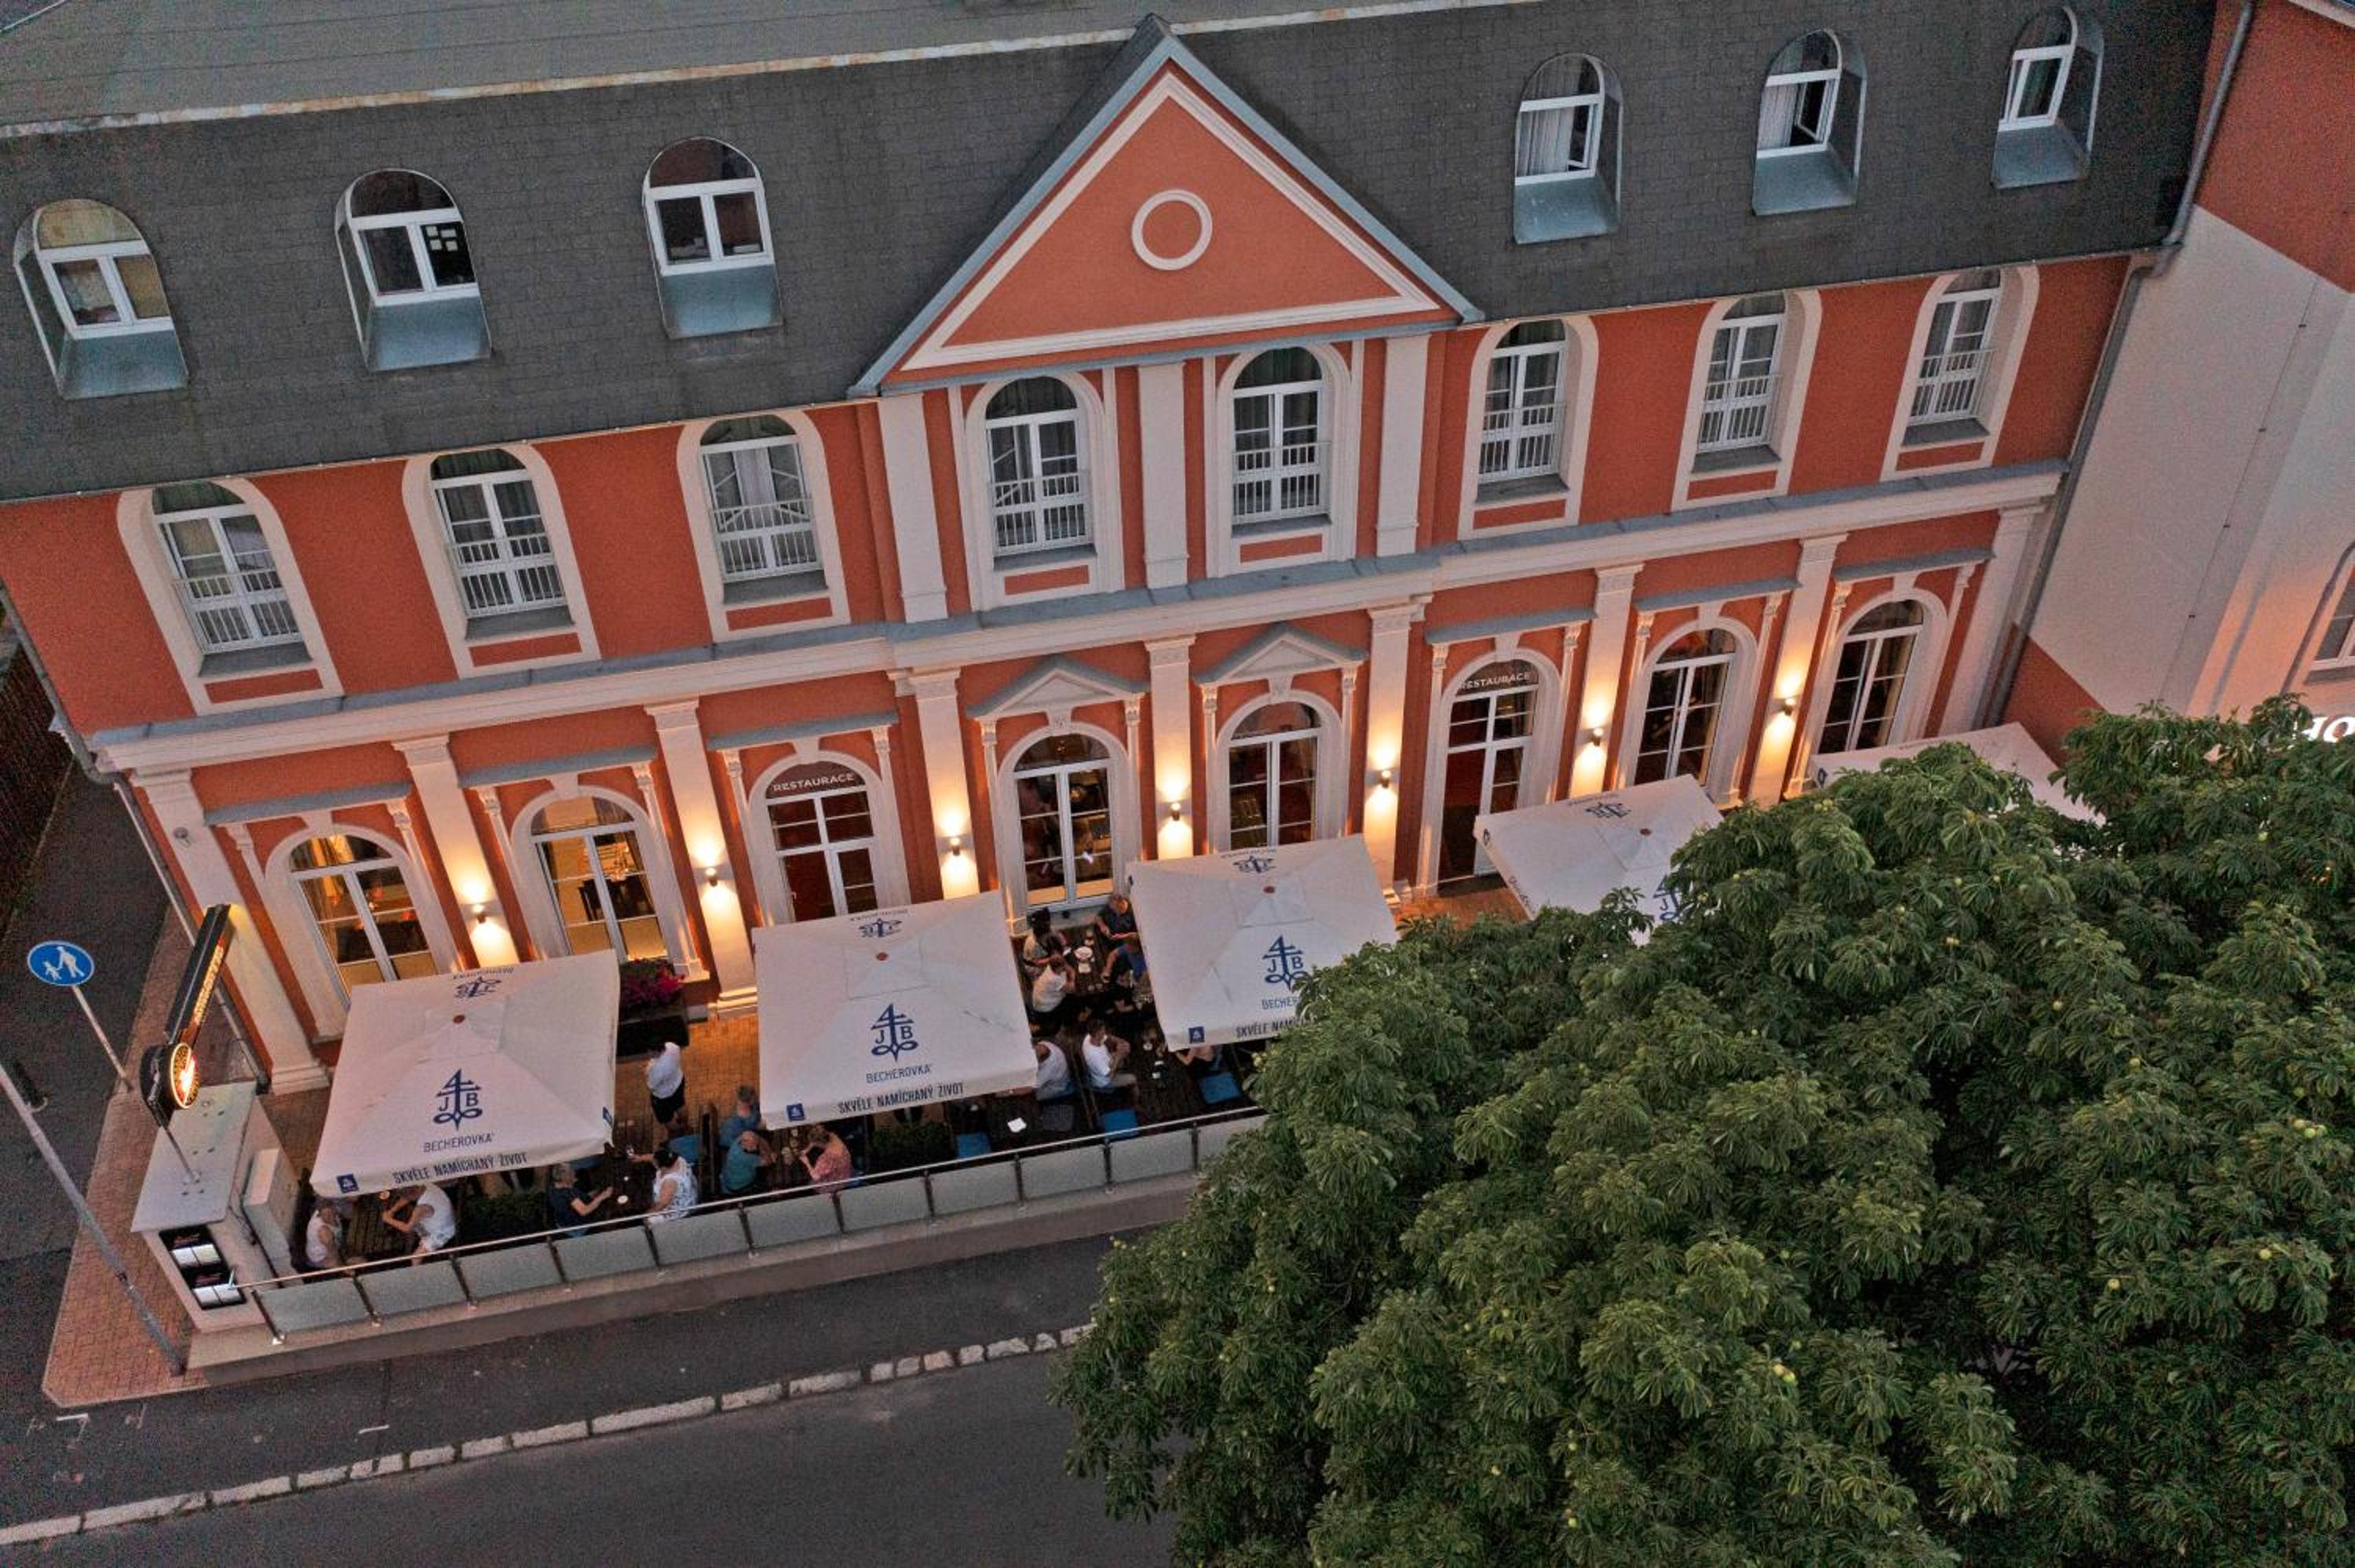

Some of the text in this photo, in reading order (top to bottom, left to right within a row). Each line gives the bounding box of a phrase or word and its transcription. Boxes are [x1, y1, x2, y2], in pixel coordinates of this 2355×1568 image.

[773, 773, 854, 792] RESTAURACE
[866, 1064, 931, 1084] BECHEROVKA
[423, 1132, 492, 1153] BECHEROVKA
